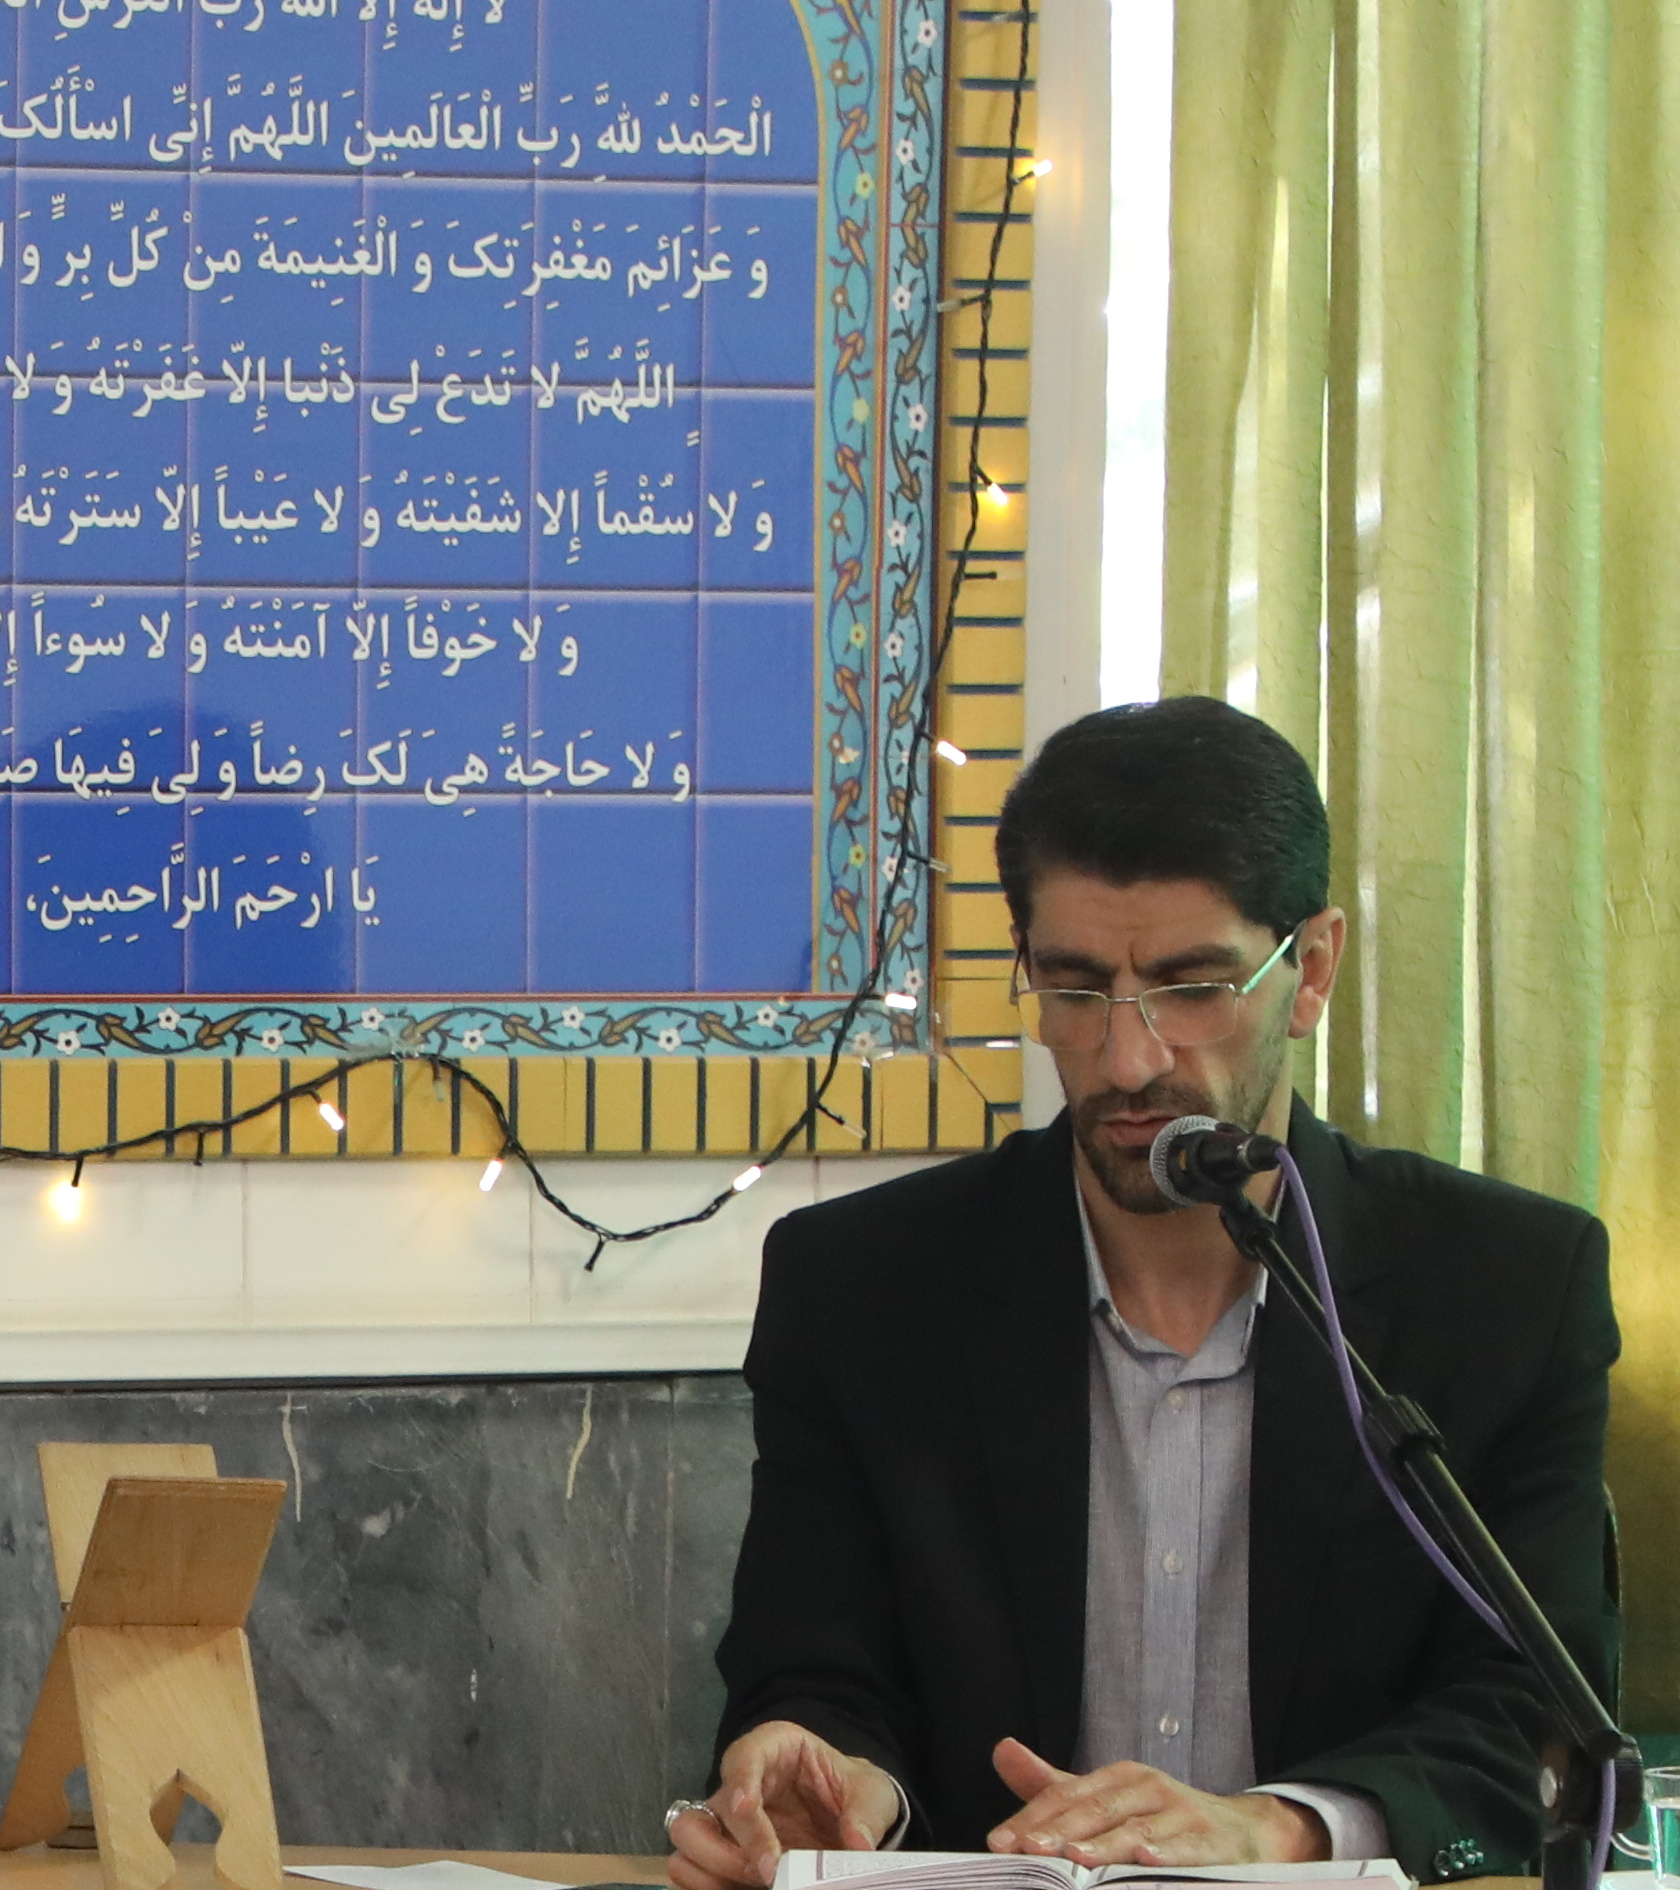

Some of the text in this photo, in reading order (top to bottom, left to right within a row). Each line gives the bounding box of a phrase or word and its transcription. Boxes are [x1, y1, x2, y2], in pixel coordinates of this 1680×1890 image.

[5, 352, 35, 399] لا
[531, 362, 560, 408] لا
[314, 486, 344, 532] لا
[708, 491, 737, 537] لا
